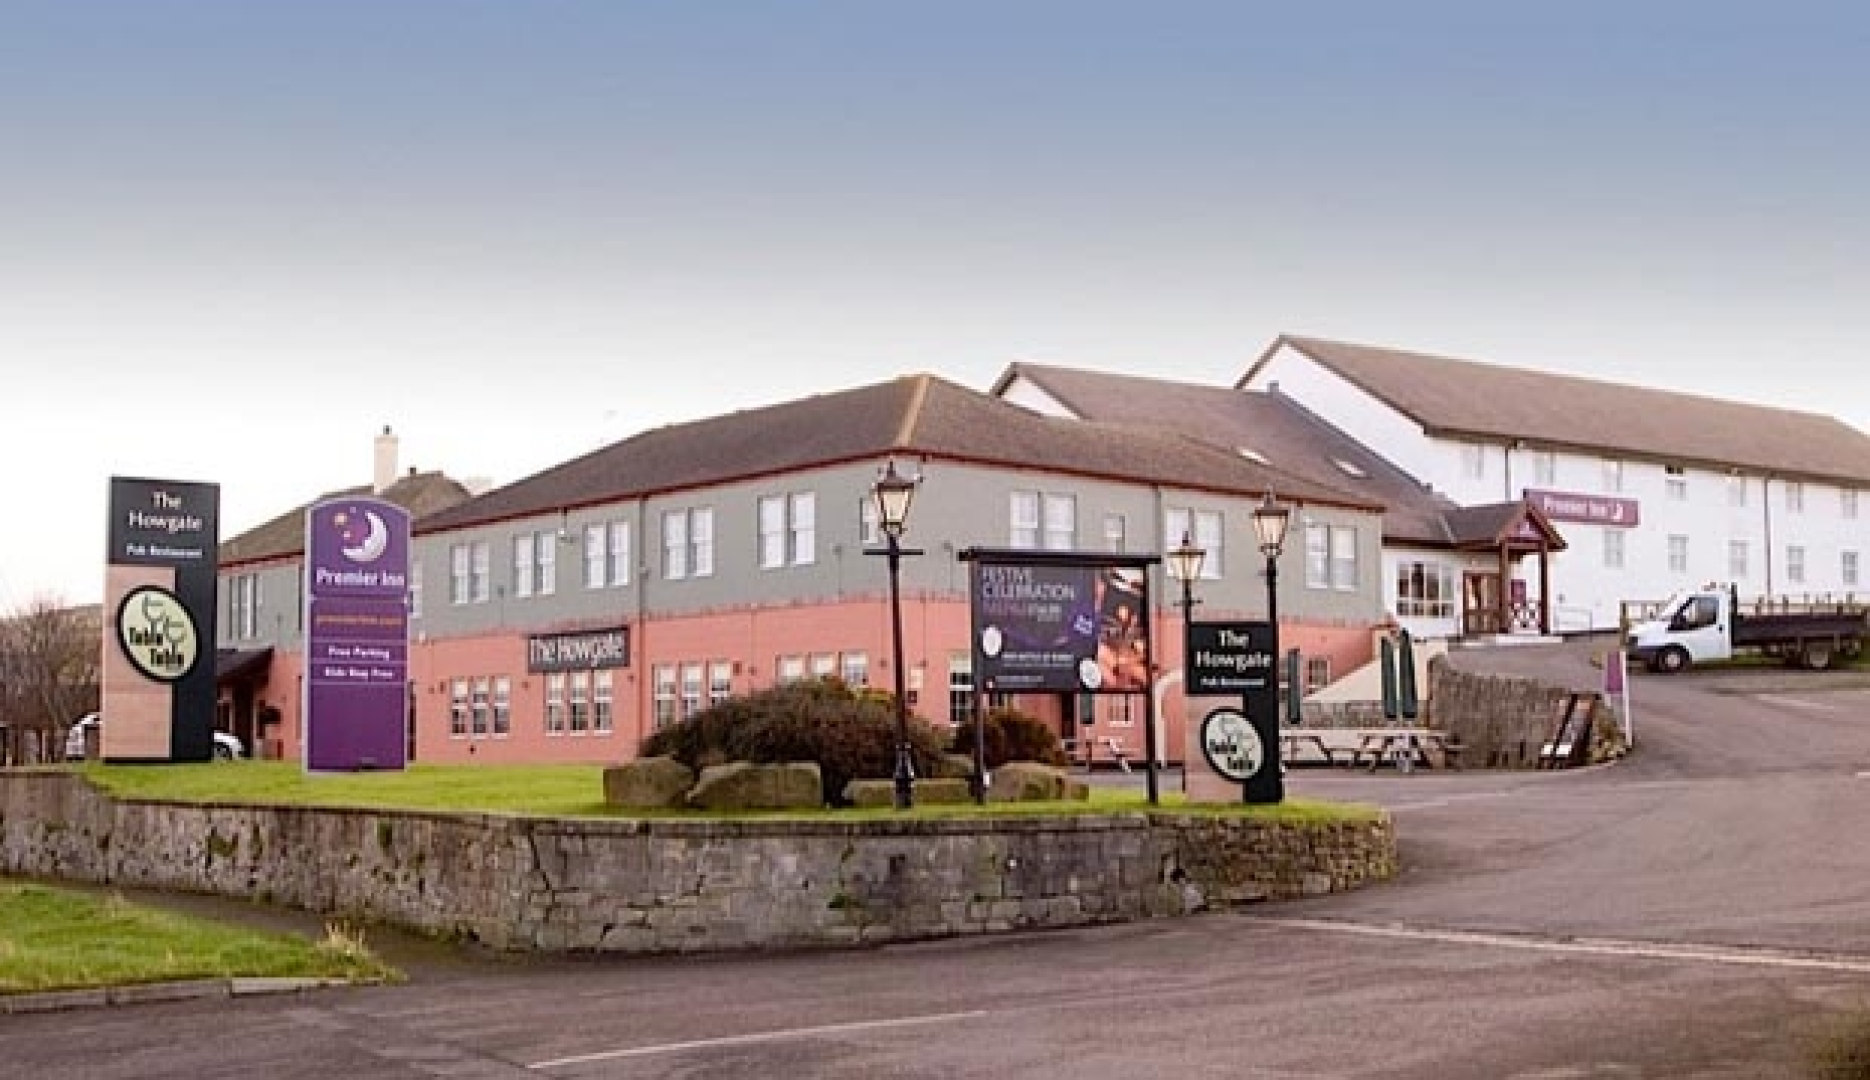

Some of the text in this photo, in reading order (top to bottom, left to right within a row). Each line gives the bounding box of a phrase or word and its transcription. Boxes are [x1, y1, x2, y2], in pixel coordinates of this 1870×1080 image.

[153, 491, 182, 509] The
[1543, 494, 1607, 517] Premier Inn
[128, 510, 202, 534] Howgate
[126, 543, 203, 559] Pub Restaurant
[316, 567, 405, 586] Premier Inn
[983, 566, 1032, 583] FESTIVE
[982, 583, 1075, 600] CELEBRATION
[129, 627, 164, 647] Table
[1218, 629, 1250, 649] The
[150, 648, 185, 670] Table
[530, 633, 623, 668] The Howgate
[1196, 650, 1272, 674] Howgate
